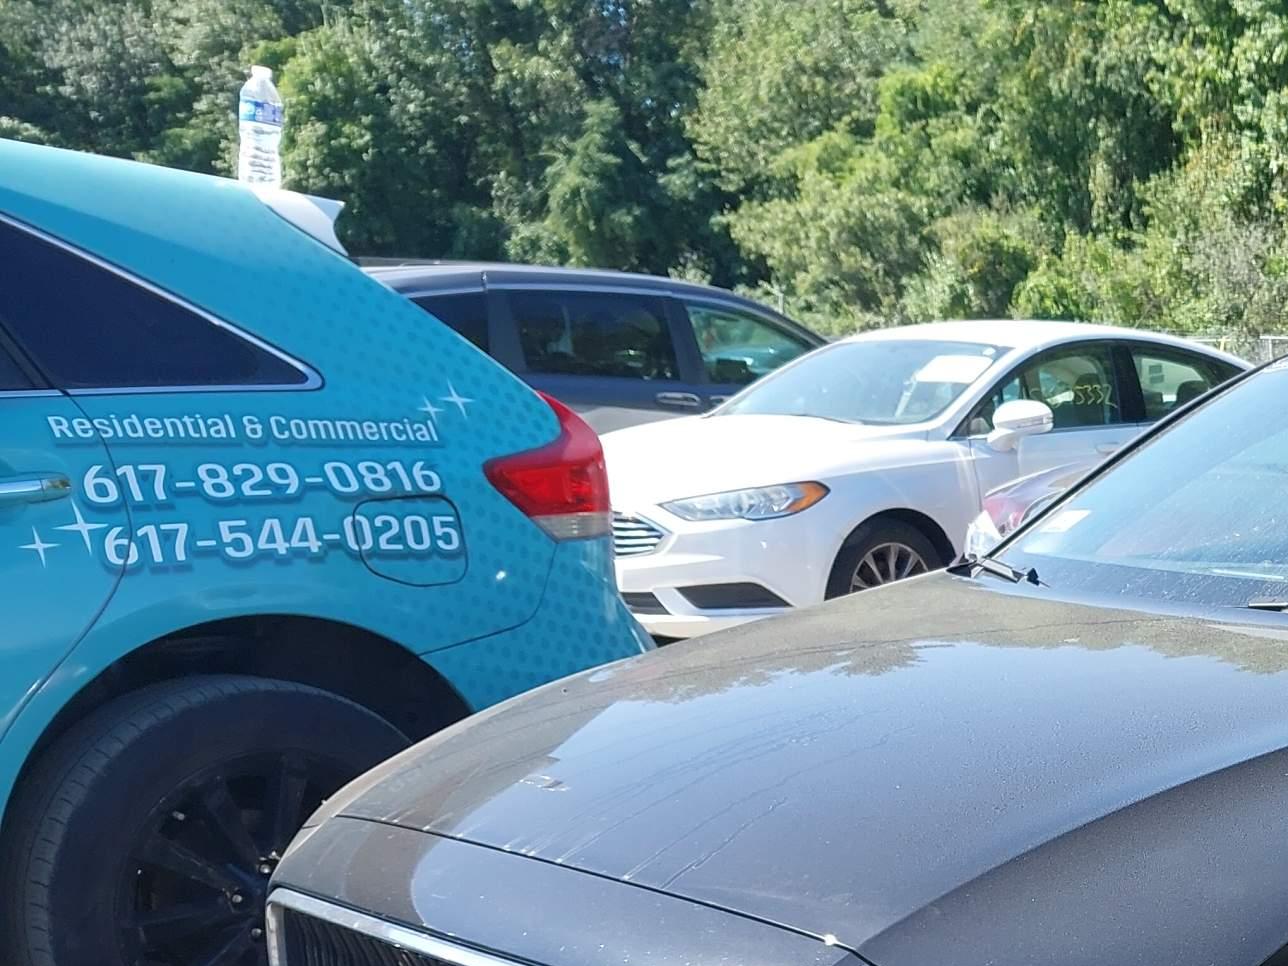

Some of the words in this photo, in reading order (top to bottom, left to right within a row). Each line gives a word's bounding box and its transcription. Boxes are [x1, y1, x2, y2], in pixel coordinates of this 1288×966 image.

[47, 414, 236, 438] Residential
[242, 416, 263, 439] &
[270, 416, 439, 442] Commercial
[83, 461, 442, 503] 617-829-0816
[104, 515, 460, 565] 617-544-0205
